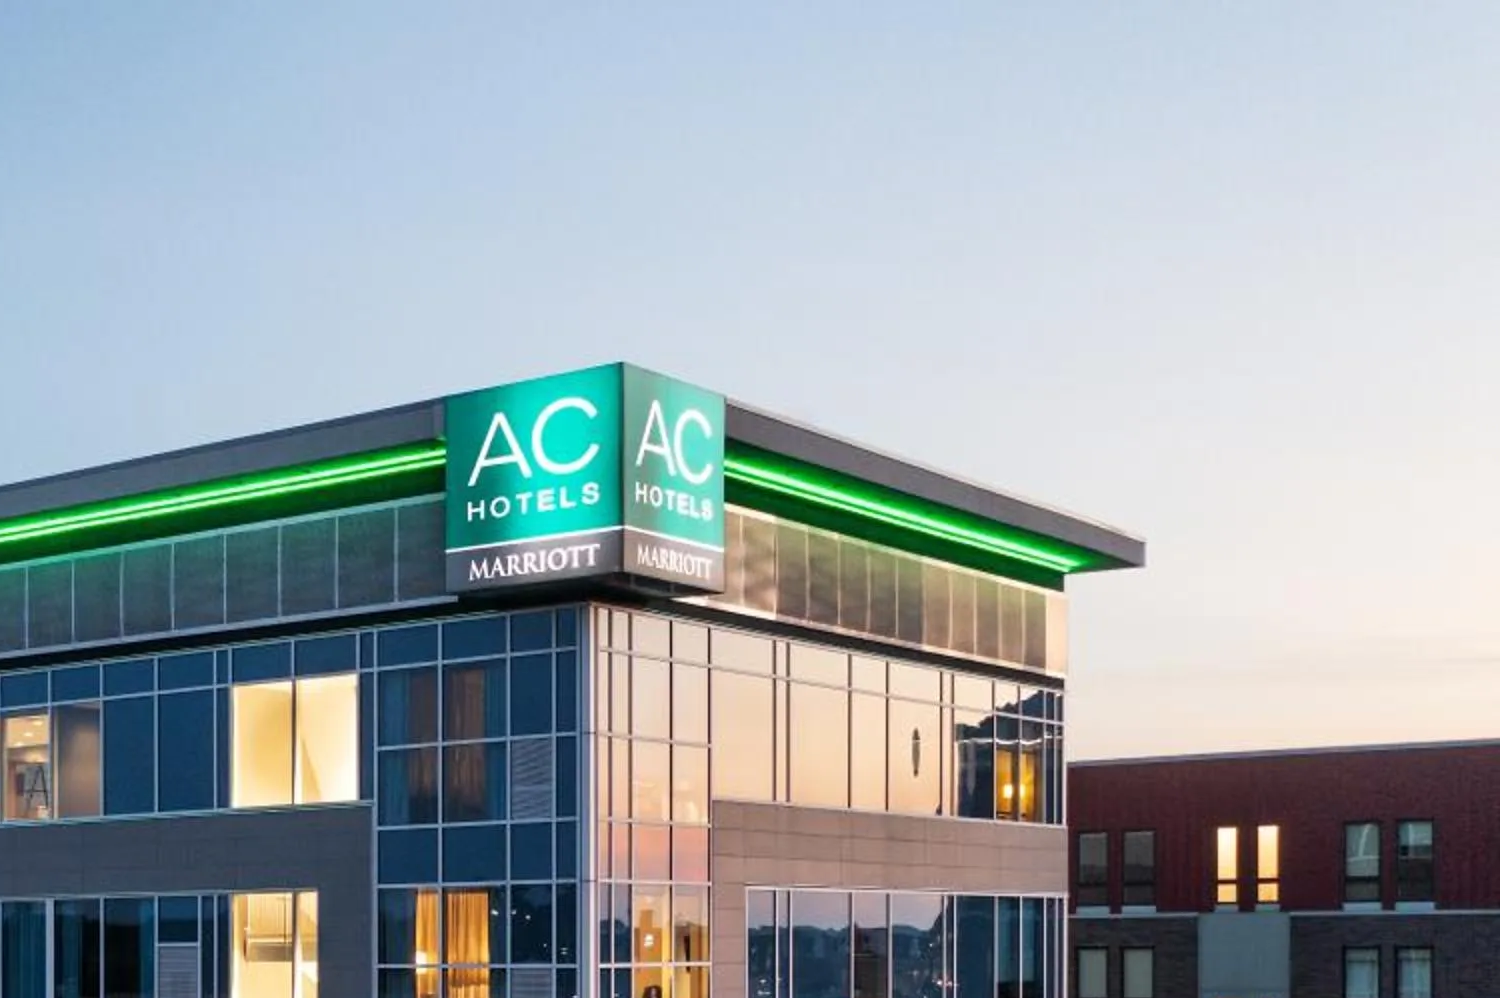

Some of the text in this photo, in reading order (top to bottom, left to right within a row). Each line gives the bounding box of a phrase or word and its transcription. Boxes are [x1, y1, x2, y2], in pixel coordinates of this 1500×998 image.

[467, 396, 600, 487] AC
[635, 399, 714, 485] AC
[467, 482, 600, 522] HOTELS
[635, 481, 714, 521] HOTELS
[468, 543, 601, 582] MARRIOTT
[637, 544, 713, 580] MARRIOTT
